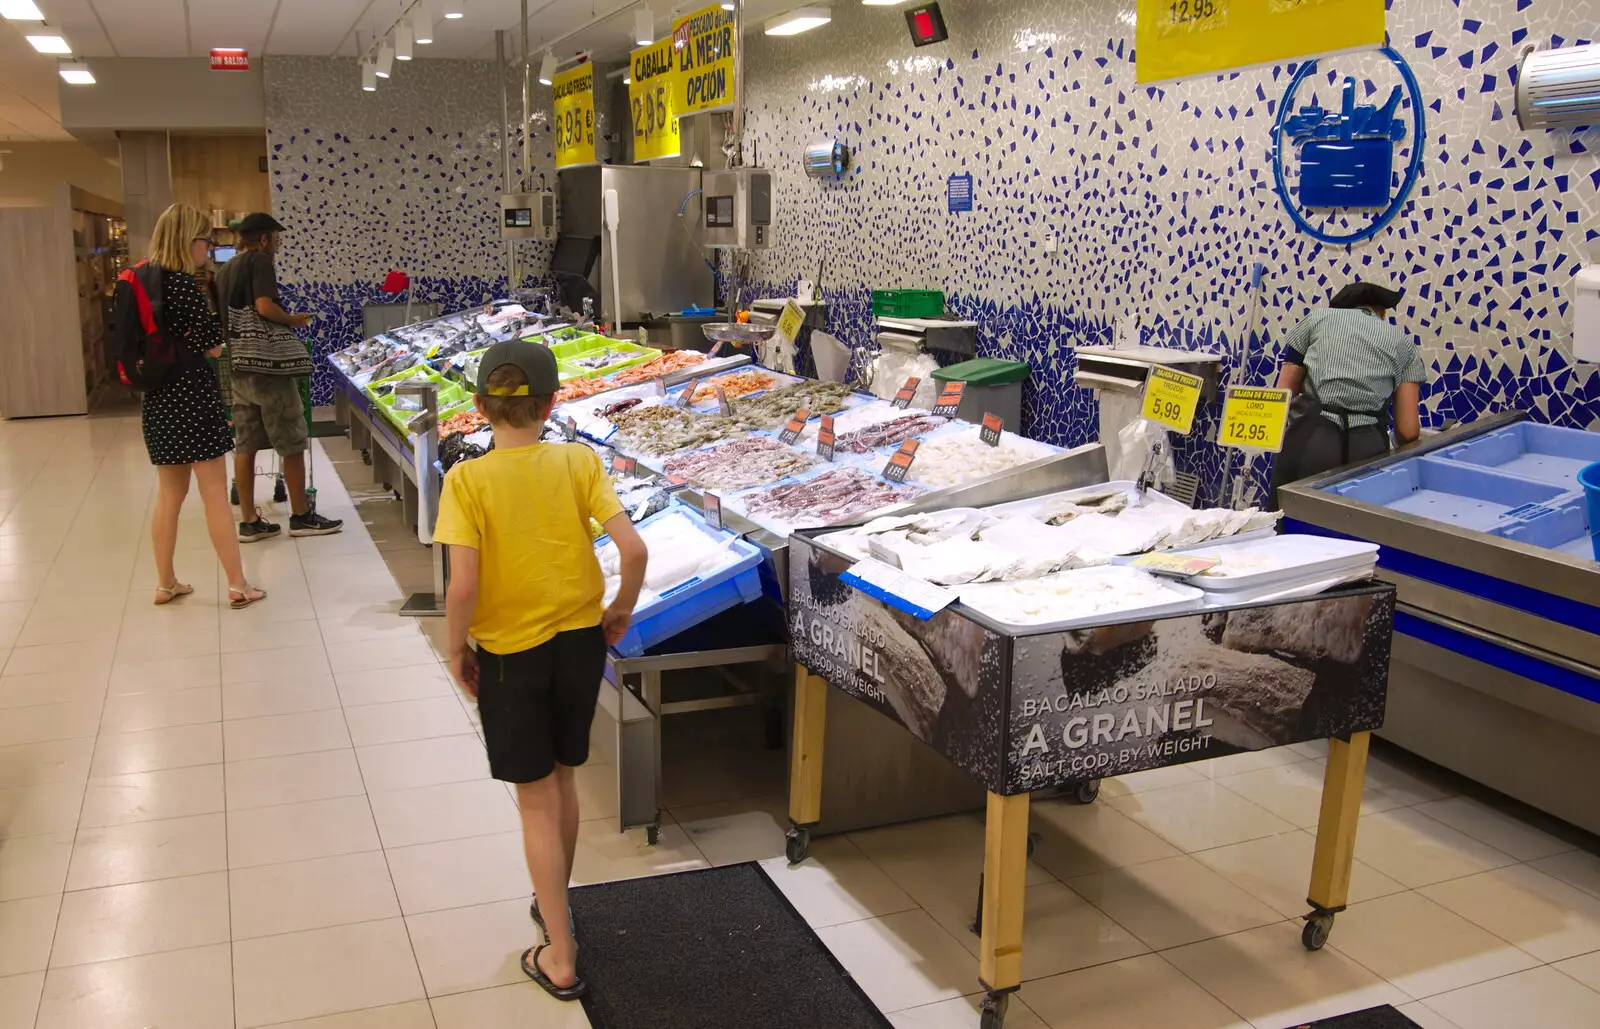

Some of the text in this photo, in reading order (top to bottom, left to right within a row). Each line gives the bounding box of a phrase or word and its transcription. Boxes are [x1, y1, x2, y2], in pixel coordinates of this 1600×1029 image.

[690, 11, 713, 37] PESCADO
[211, 56, 249, 65] SIN SALIDA
[635, 46, 673, 82] CABALLA
[680, 26, 731, 72] LA MEJOR
[573, 74, 593, 95] FRESCO
[687, 65, 726, 107] OPCIÓN
[556, 107, 582, 154] 6,95
[633, 87, 667, 144] 2,95
[1164, 381, 1184, 393] TROZOS
[1234, 390, 1253, 398] BAJADA
[1262, 392, 1282, 400] PRECIO
[1246, 402, 1264, 410] LOMO
[794, 587, 887, 648] BACALAO SALADO
[794, 610, 885, 684] A GRANEL
[794, 640, 813, 660] SALT
[836, 665, 848, 681] BY
[850, 673, 886, 704] WEIGHT
[1023, 674, 1218, 718] BACALAO SALADO
[1021, 698, 1214, 757] A GRANEL
[1020, 760, 1063, 780] SALT
[1119, 747, 1141, 764] BY
[1148, 734, 1213, 759] WEIGHT
